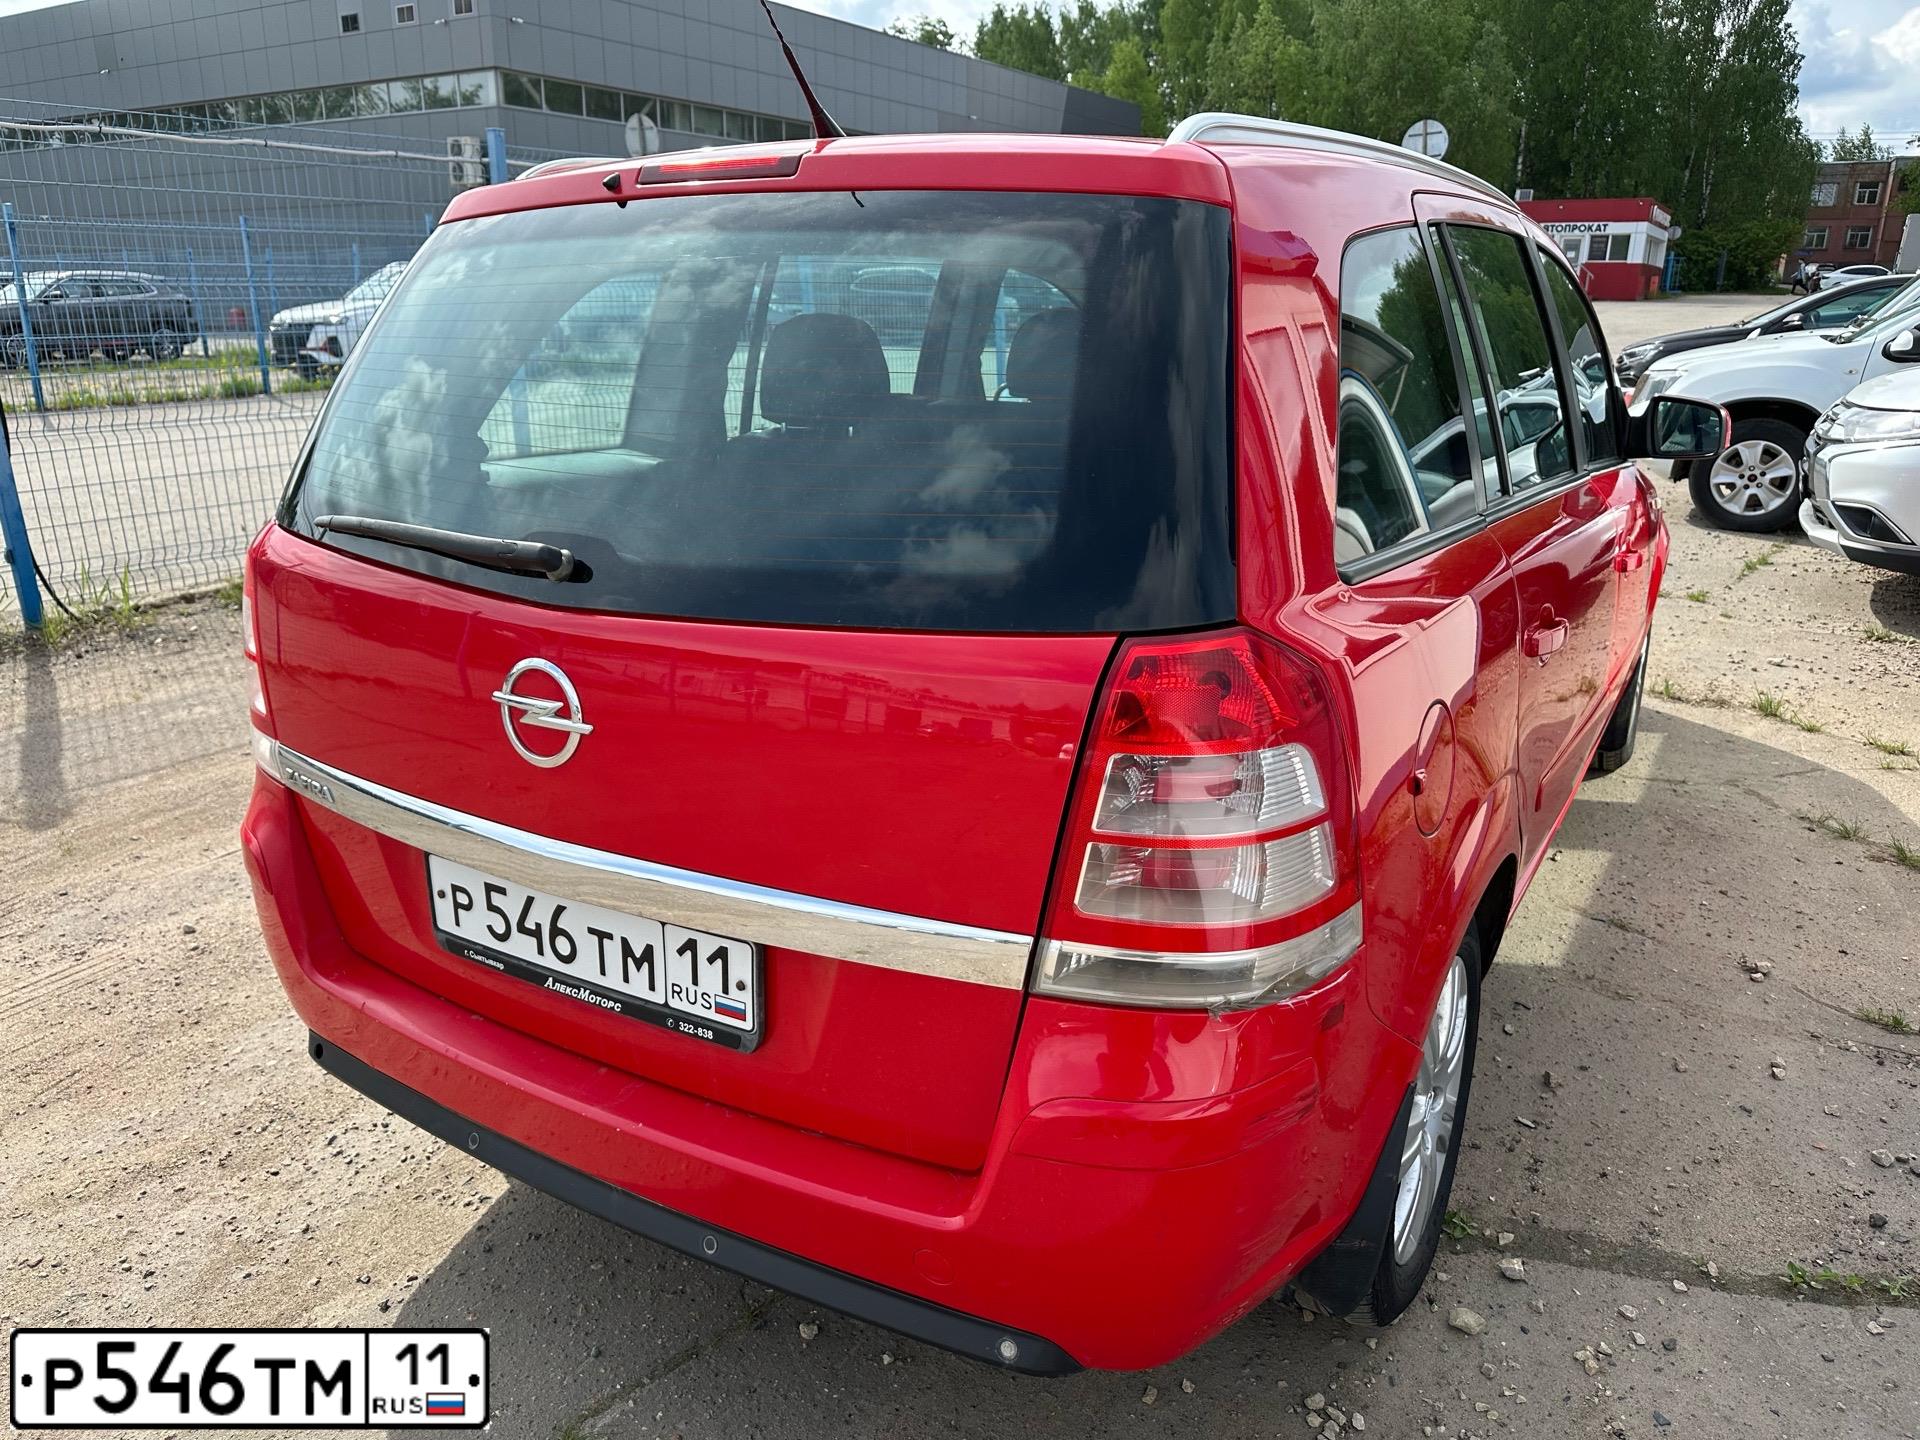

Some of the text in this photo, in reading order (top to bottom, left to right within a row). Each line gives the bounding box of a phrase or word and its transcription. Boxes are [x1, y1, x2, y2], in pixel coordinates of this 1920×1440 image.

[1543, 223, 1608, 233] ВТОПРОКАТ
[676, 937, 729, 996] 11
[671, 982, 712, 1010] RUS
[678, 1021, 713, 1040] 322-838
